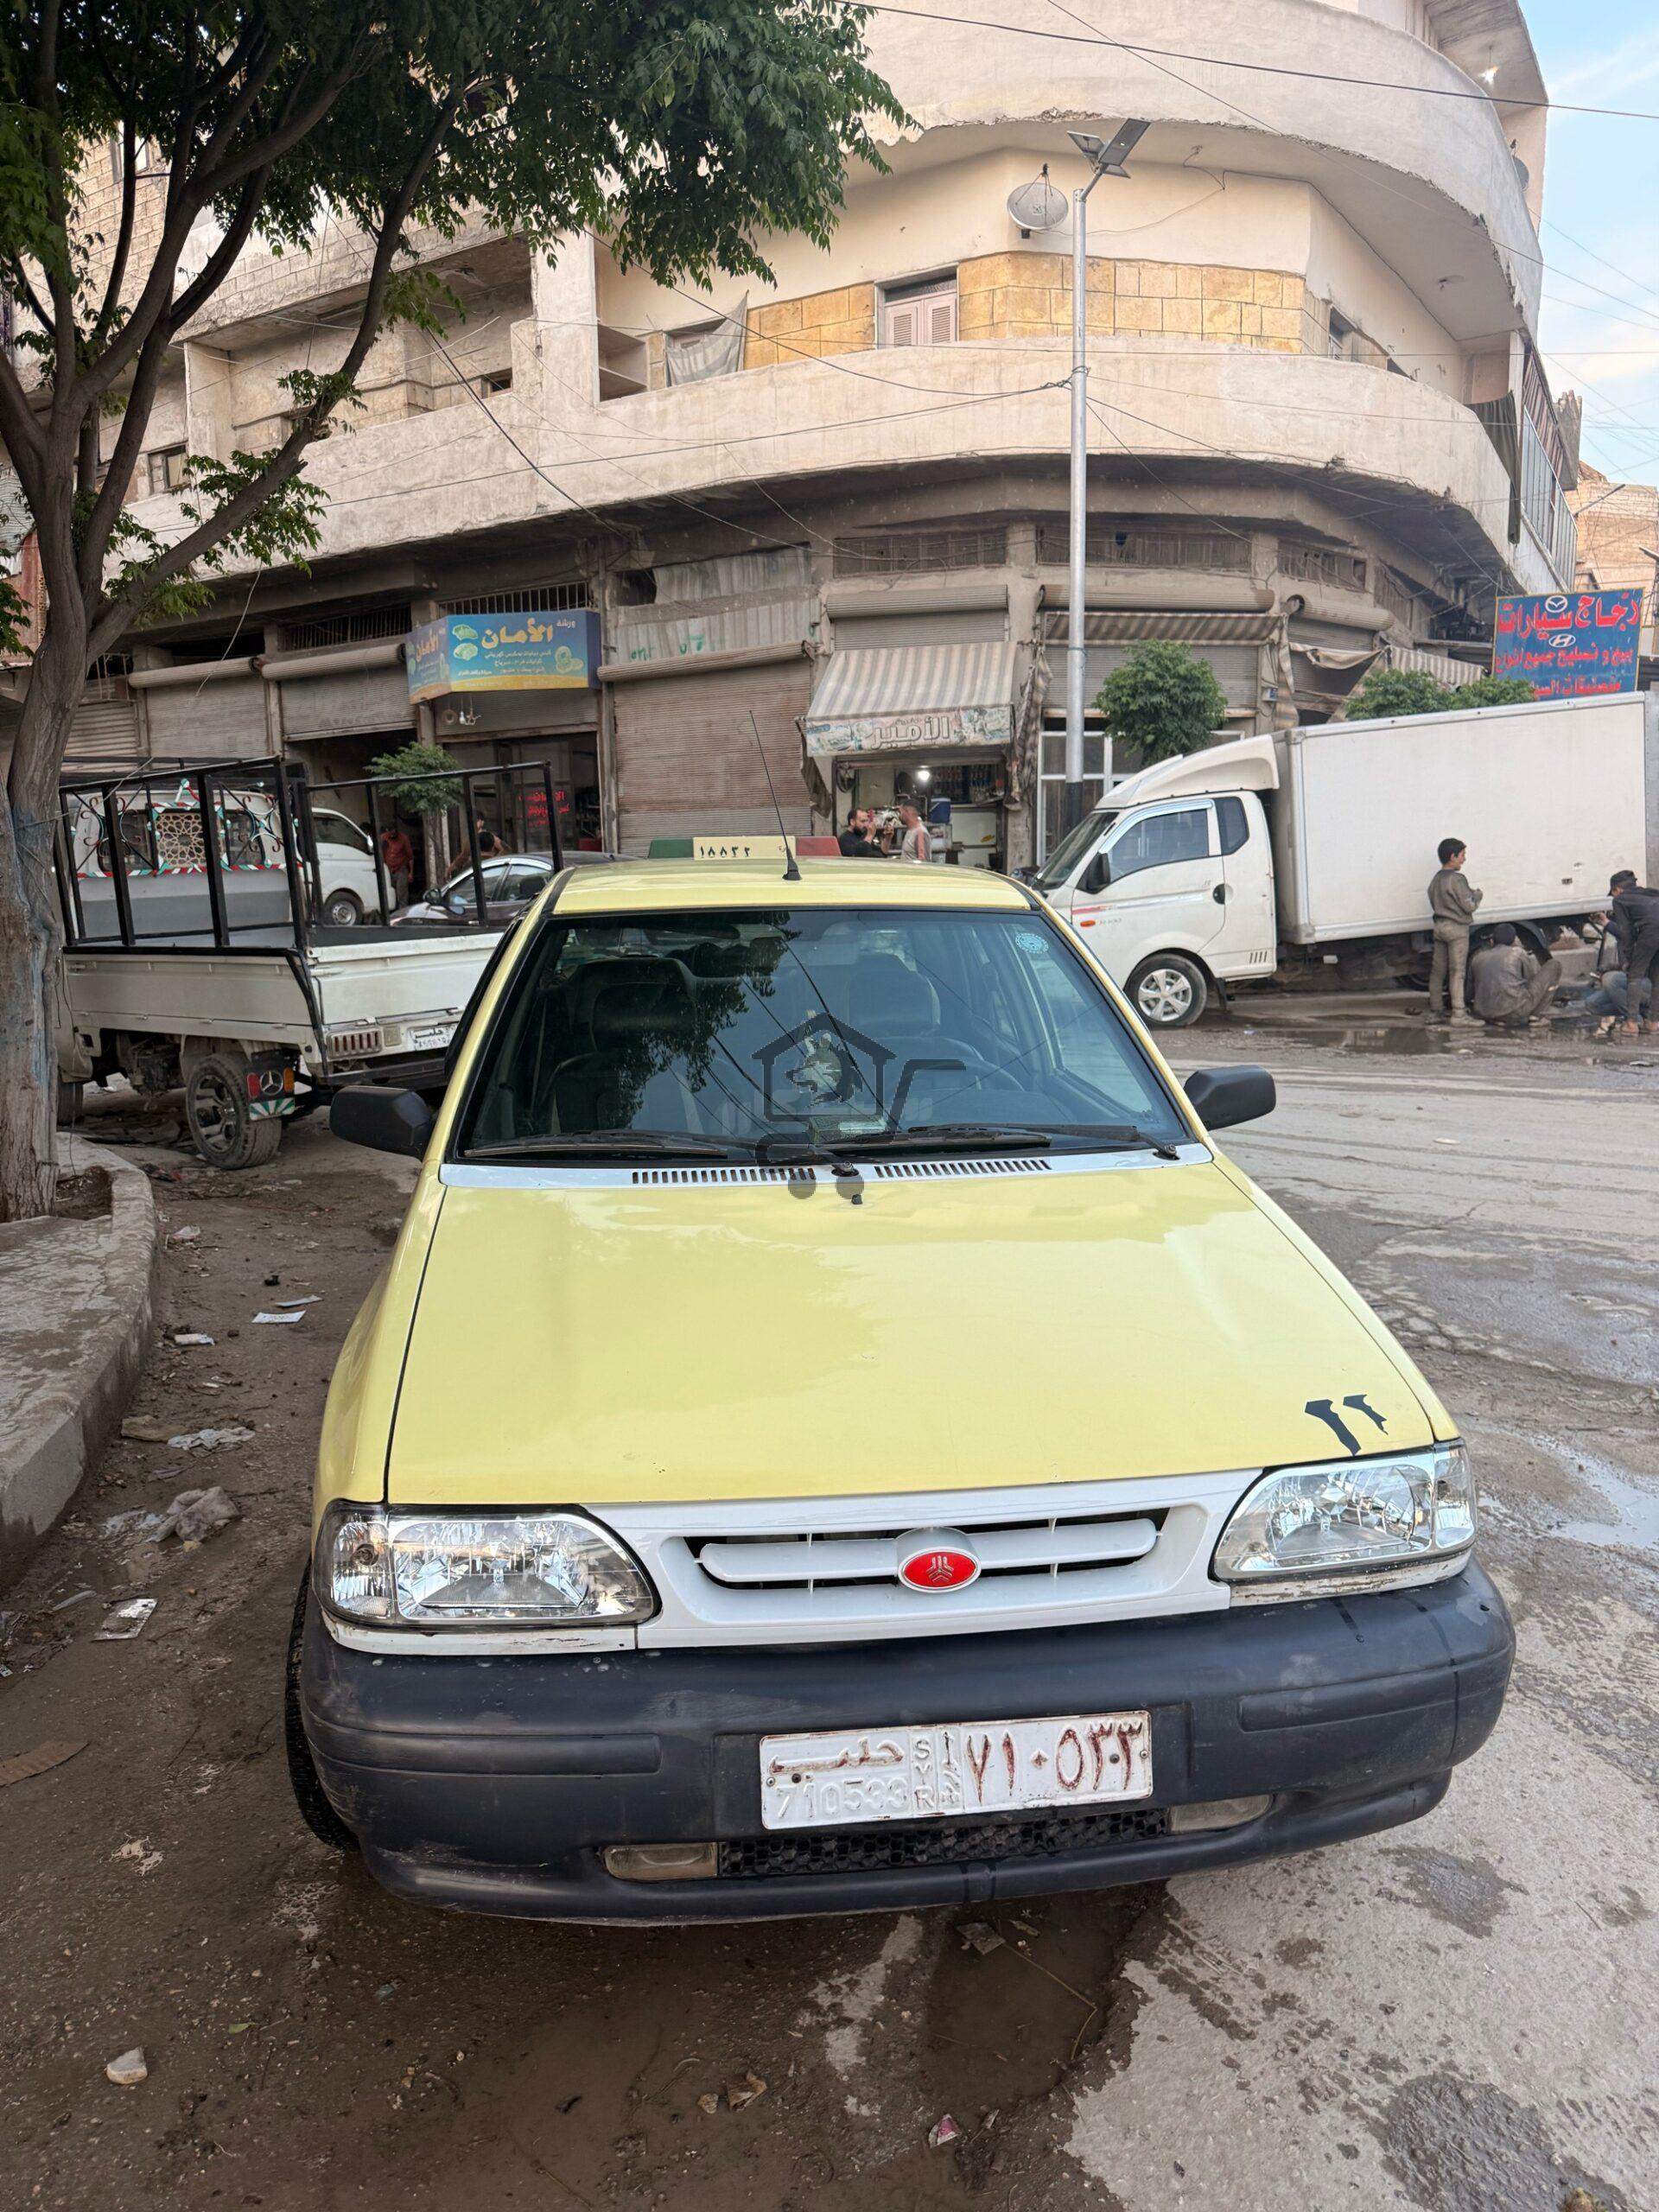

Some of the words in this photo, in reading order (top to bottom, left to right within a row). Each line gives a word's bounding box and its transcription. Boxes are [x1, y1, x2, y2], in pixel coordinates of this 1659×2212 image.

[1497, 602, 1573, 639] سيارات
[1574, 593, 1639, 632] زجاج
[480, 617, 553, 649] الأمان
[871, 716, 950, 750] الأمير
[771, 1738, 905, 1779] حلب
[777, 1776, 909, 1818] 710533
